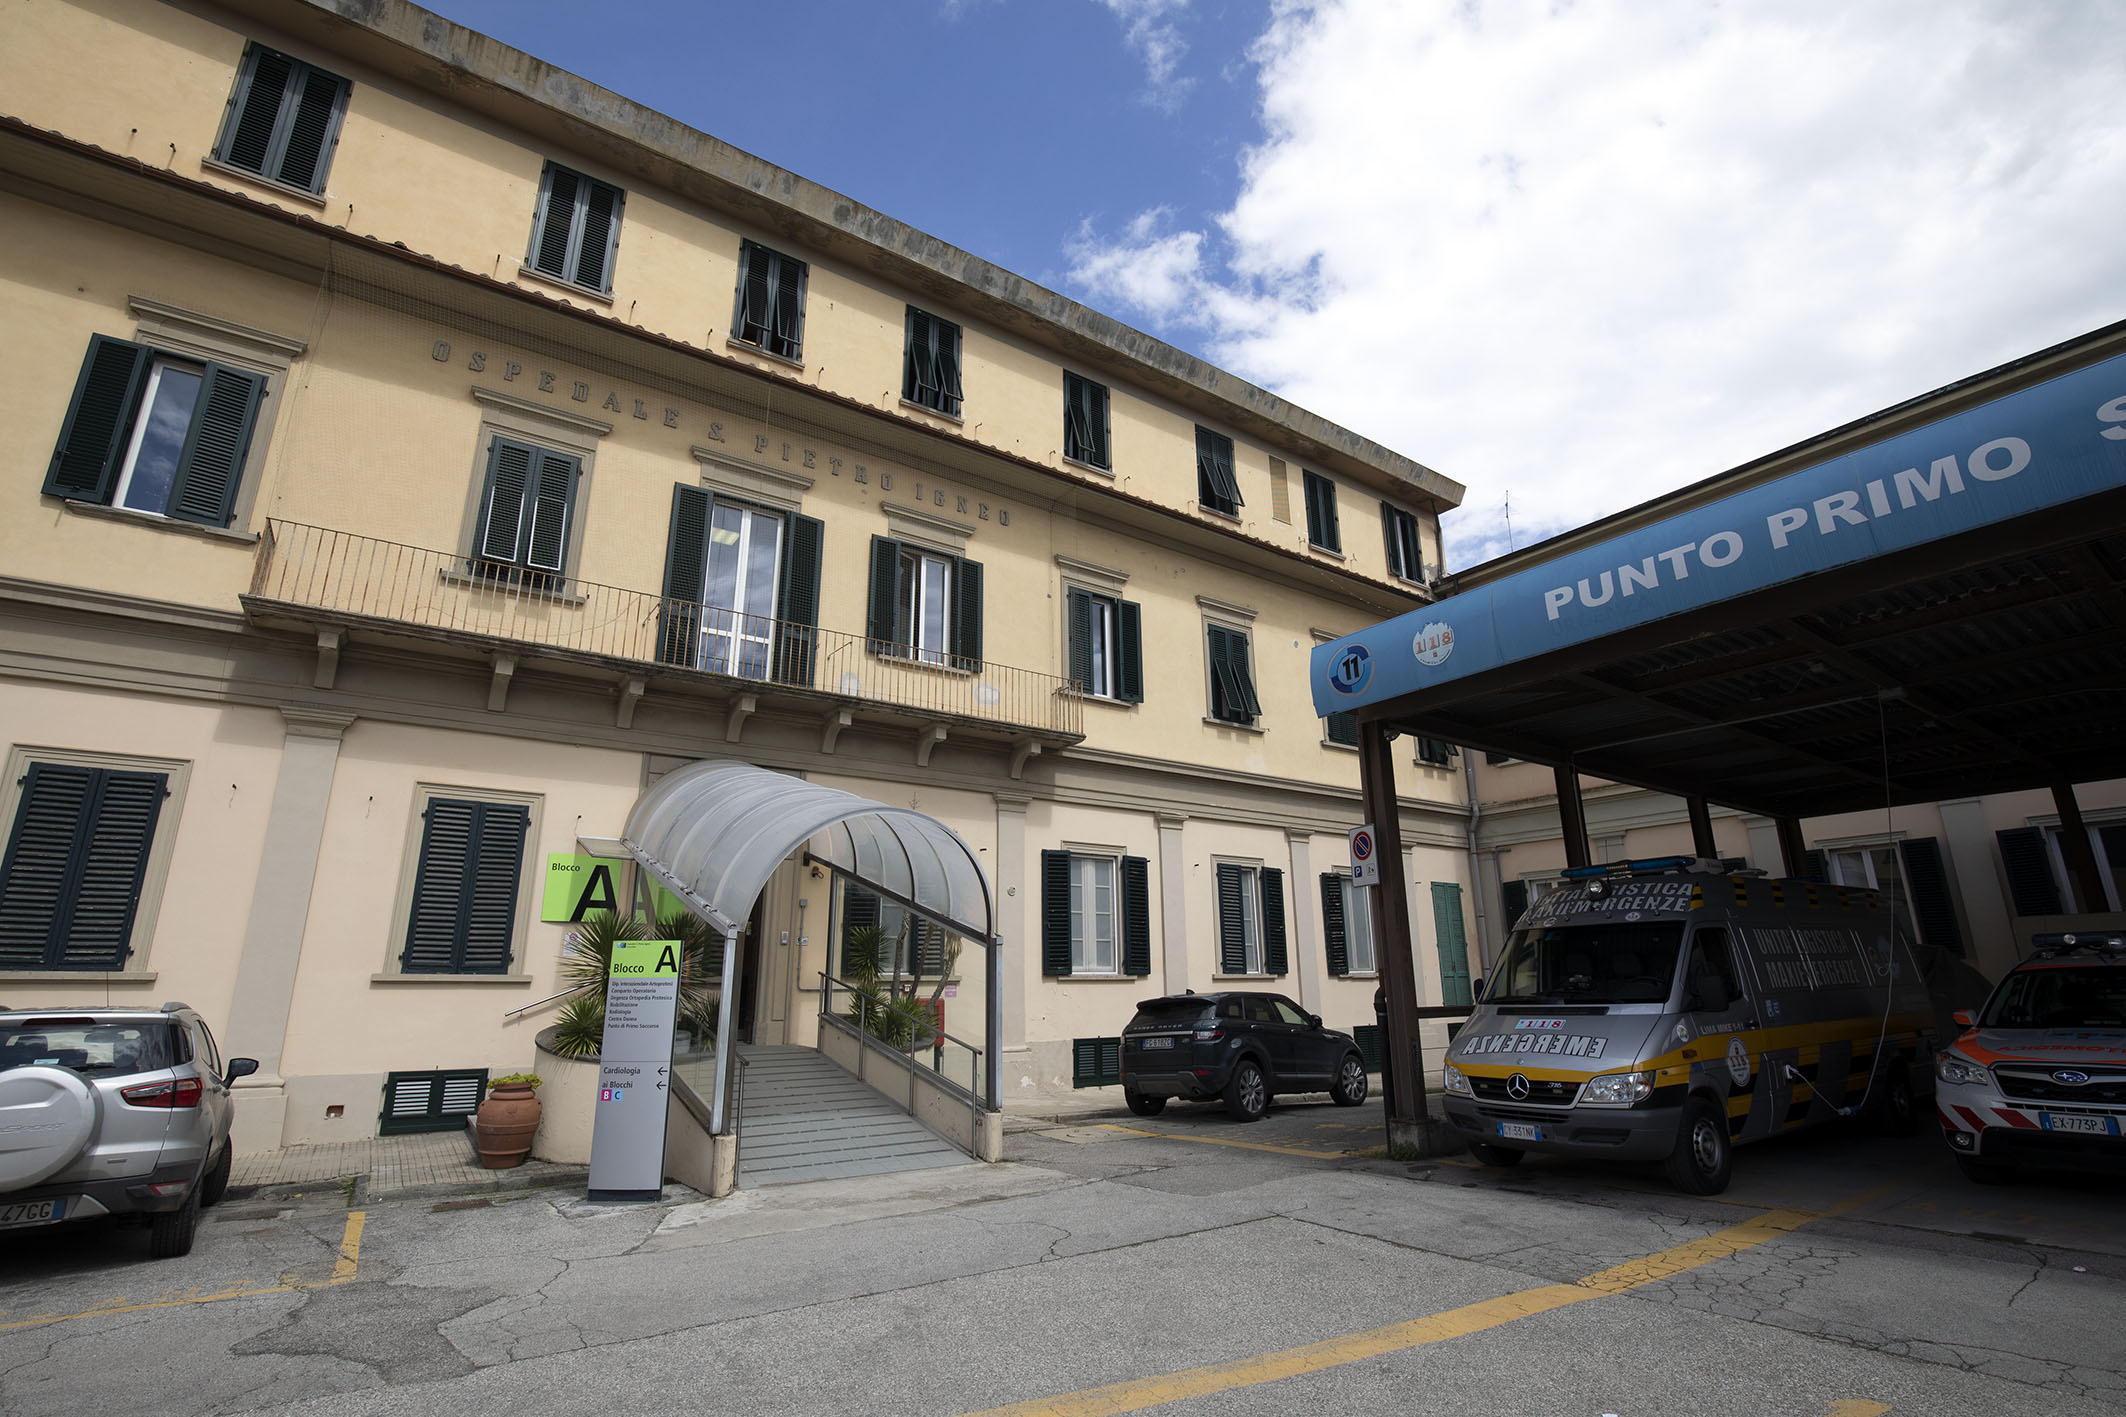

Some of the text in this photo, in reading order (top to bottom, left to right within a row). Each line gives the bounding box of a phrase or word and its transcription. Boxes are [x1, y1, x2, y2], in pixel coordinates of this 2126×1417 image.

[431, 339, 1011, 527] OSPEDALE S. PIETRO IGNEO
[1543, 529, 1745, 622] PUNTO
[1765, 435, 2033, 550] PRIMO
[1414, 631, 1454, 656] 118
[1342, 655, 1360, 681] 11
[551, 862, 581, 872] Blocco
[569, 864, 619, 923] A
[654, 945, 678, 973] A
[613, 963, 645, 973] Blocco
[1526, 1020, 1562, 1029] 118
[603, 1066, 641, 1076] Cardiologia
[610, 1081, 633, 1089] Blocchi
[603, 1090, 621, 1100] B C
